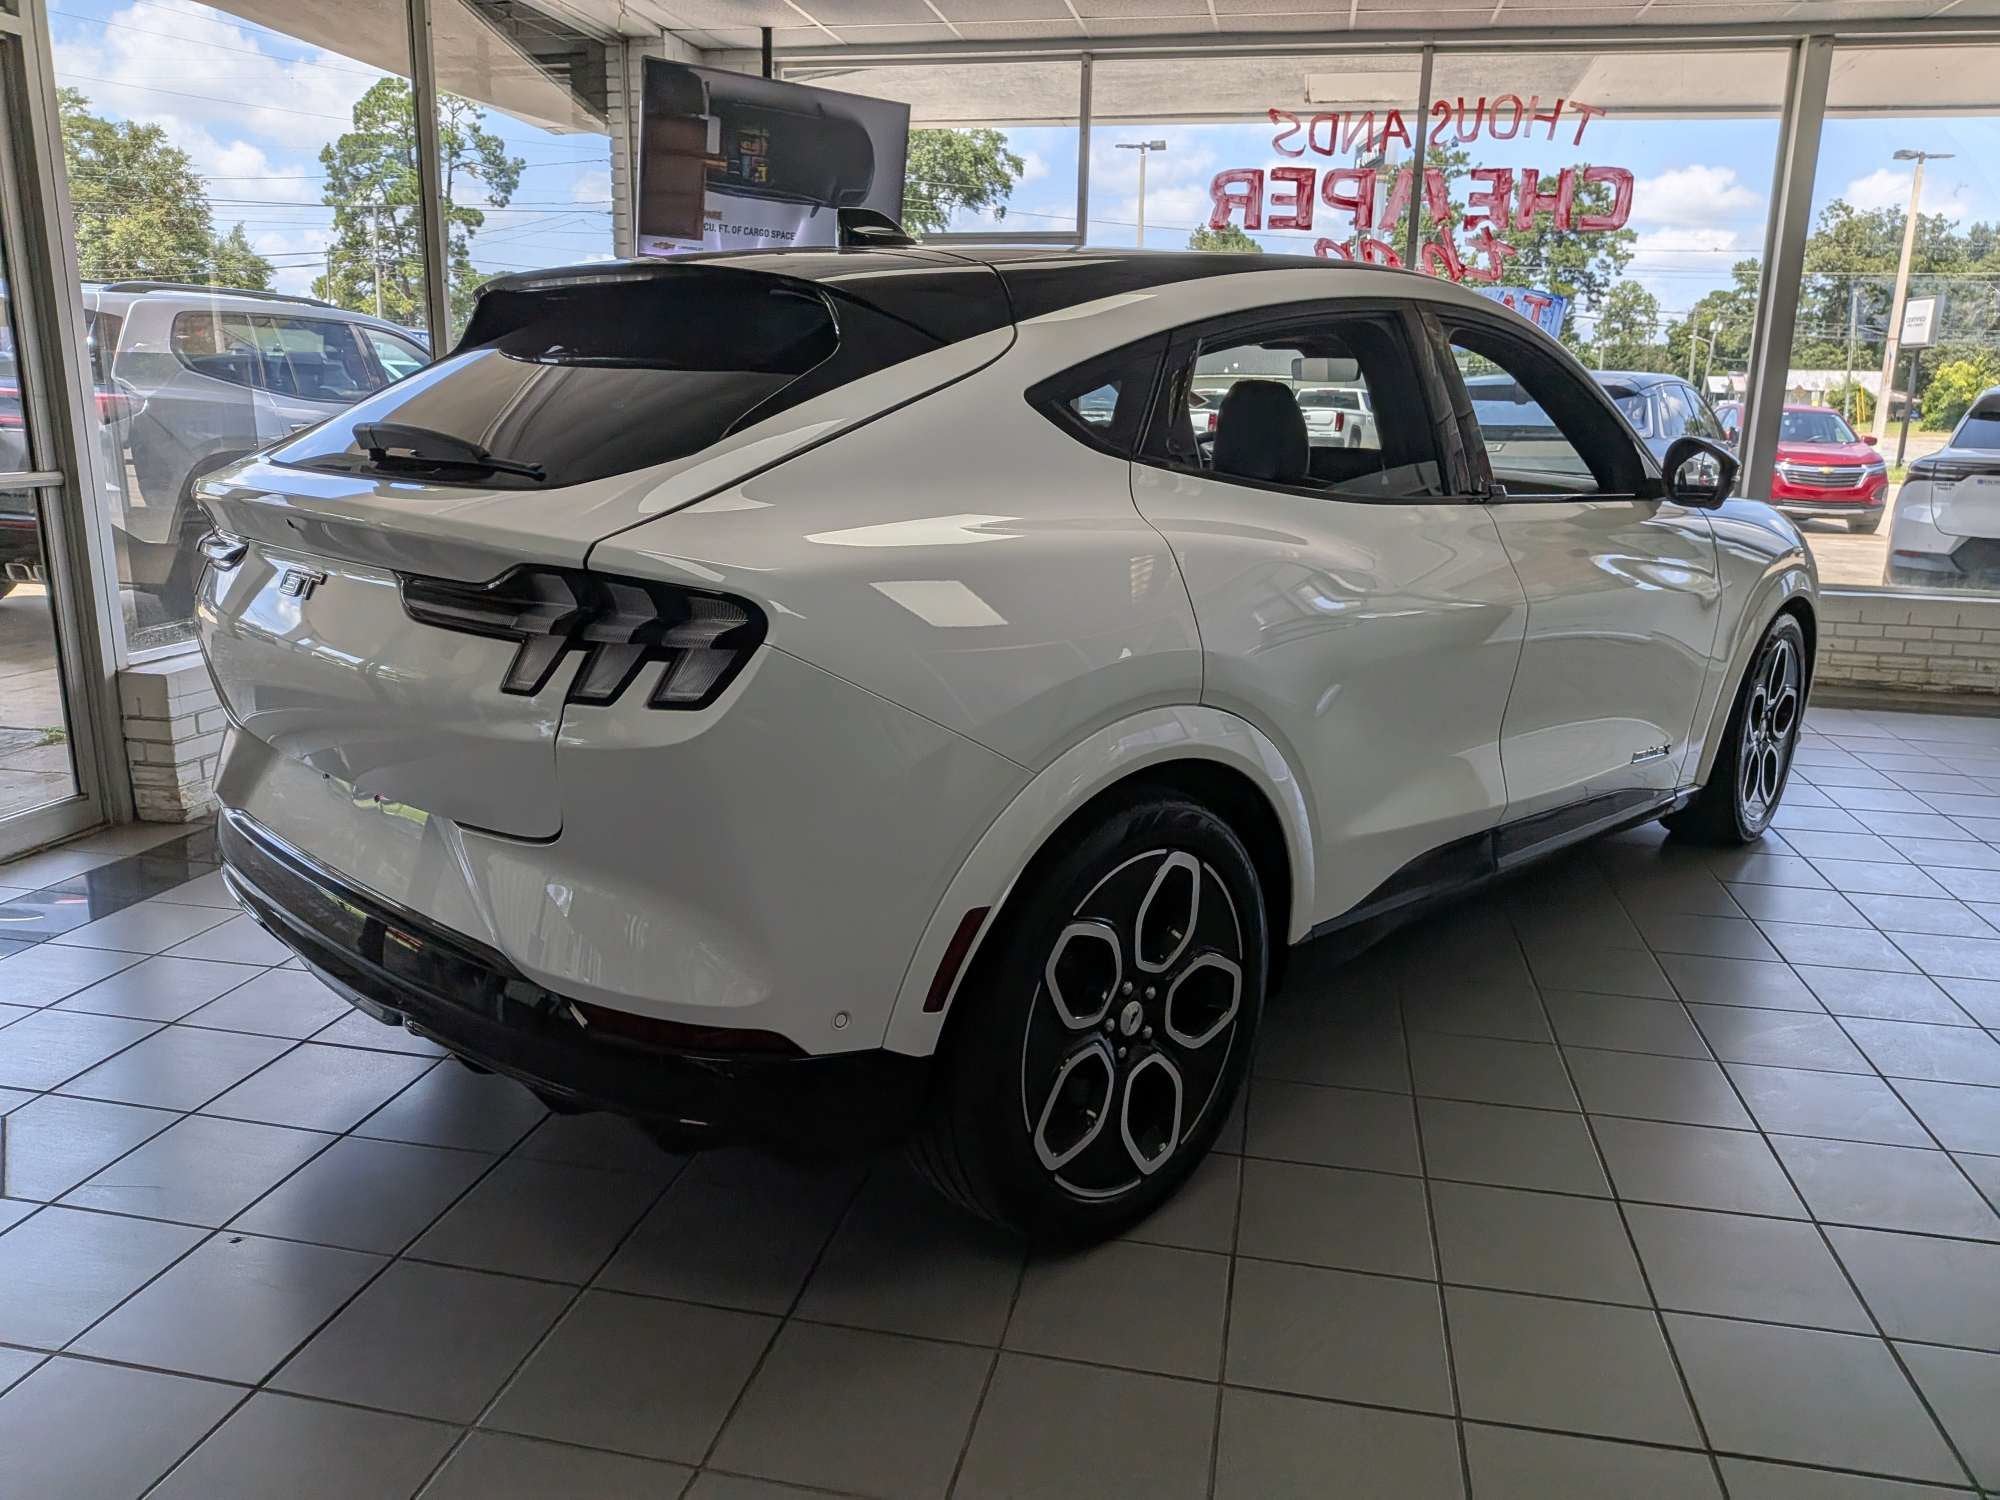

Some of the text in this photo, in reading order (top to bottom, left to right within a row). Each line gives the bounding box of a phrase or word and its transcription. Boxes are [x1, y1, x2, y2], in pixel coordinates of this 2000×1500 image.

[719, 223, 730, 233] FT.
[732, 225, 742, 234] OF
[744, 226, 770, 237] CARGO
[771, 230, 796, 240] SPACE
[279, 568, 329, 601] GT
